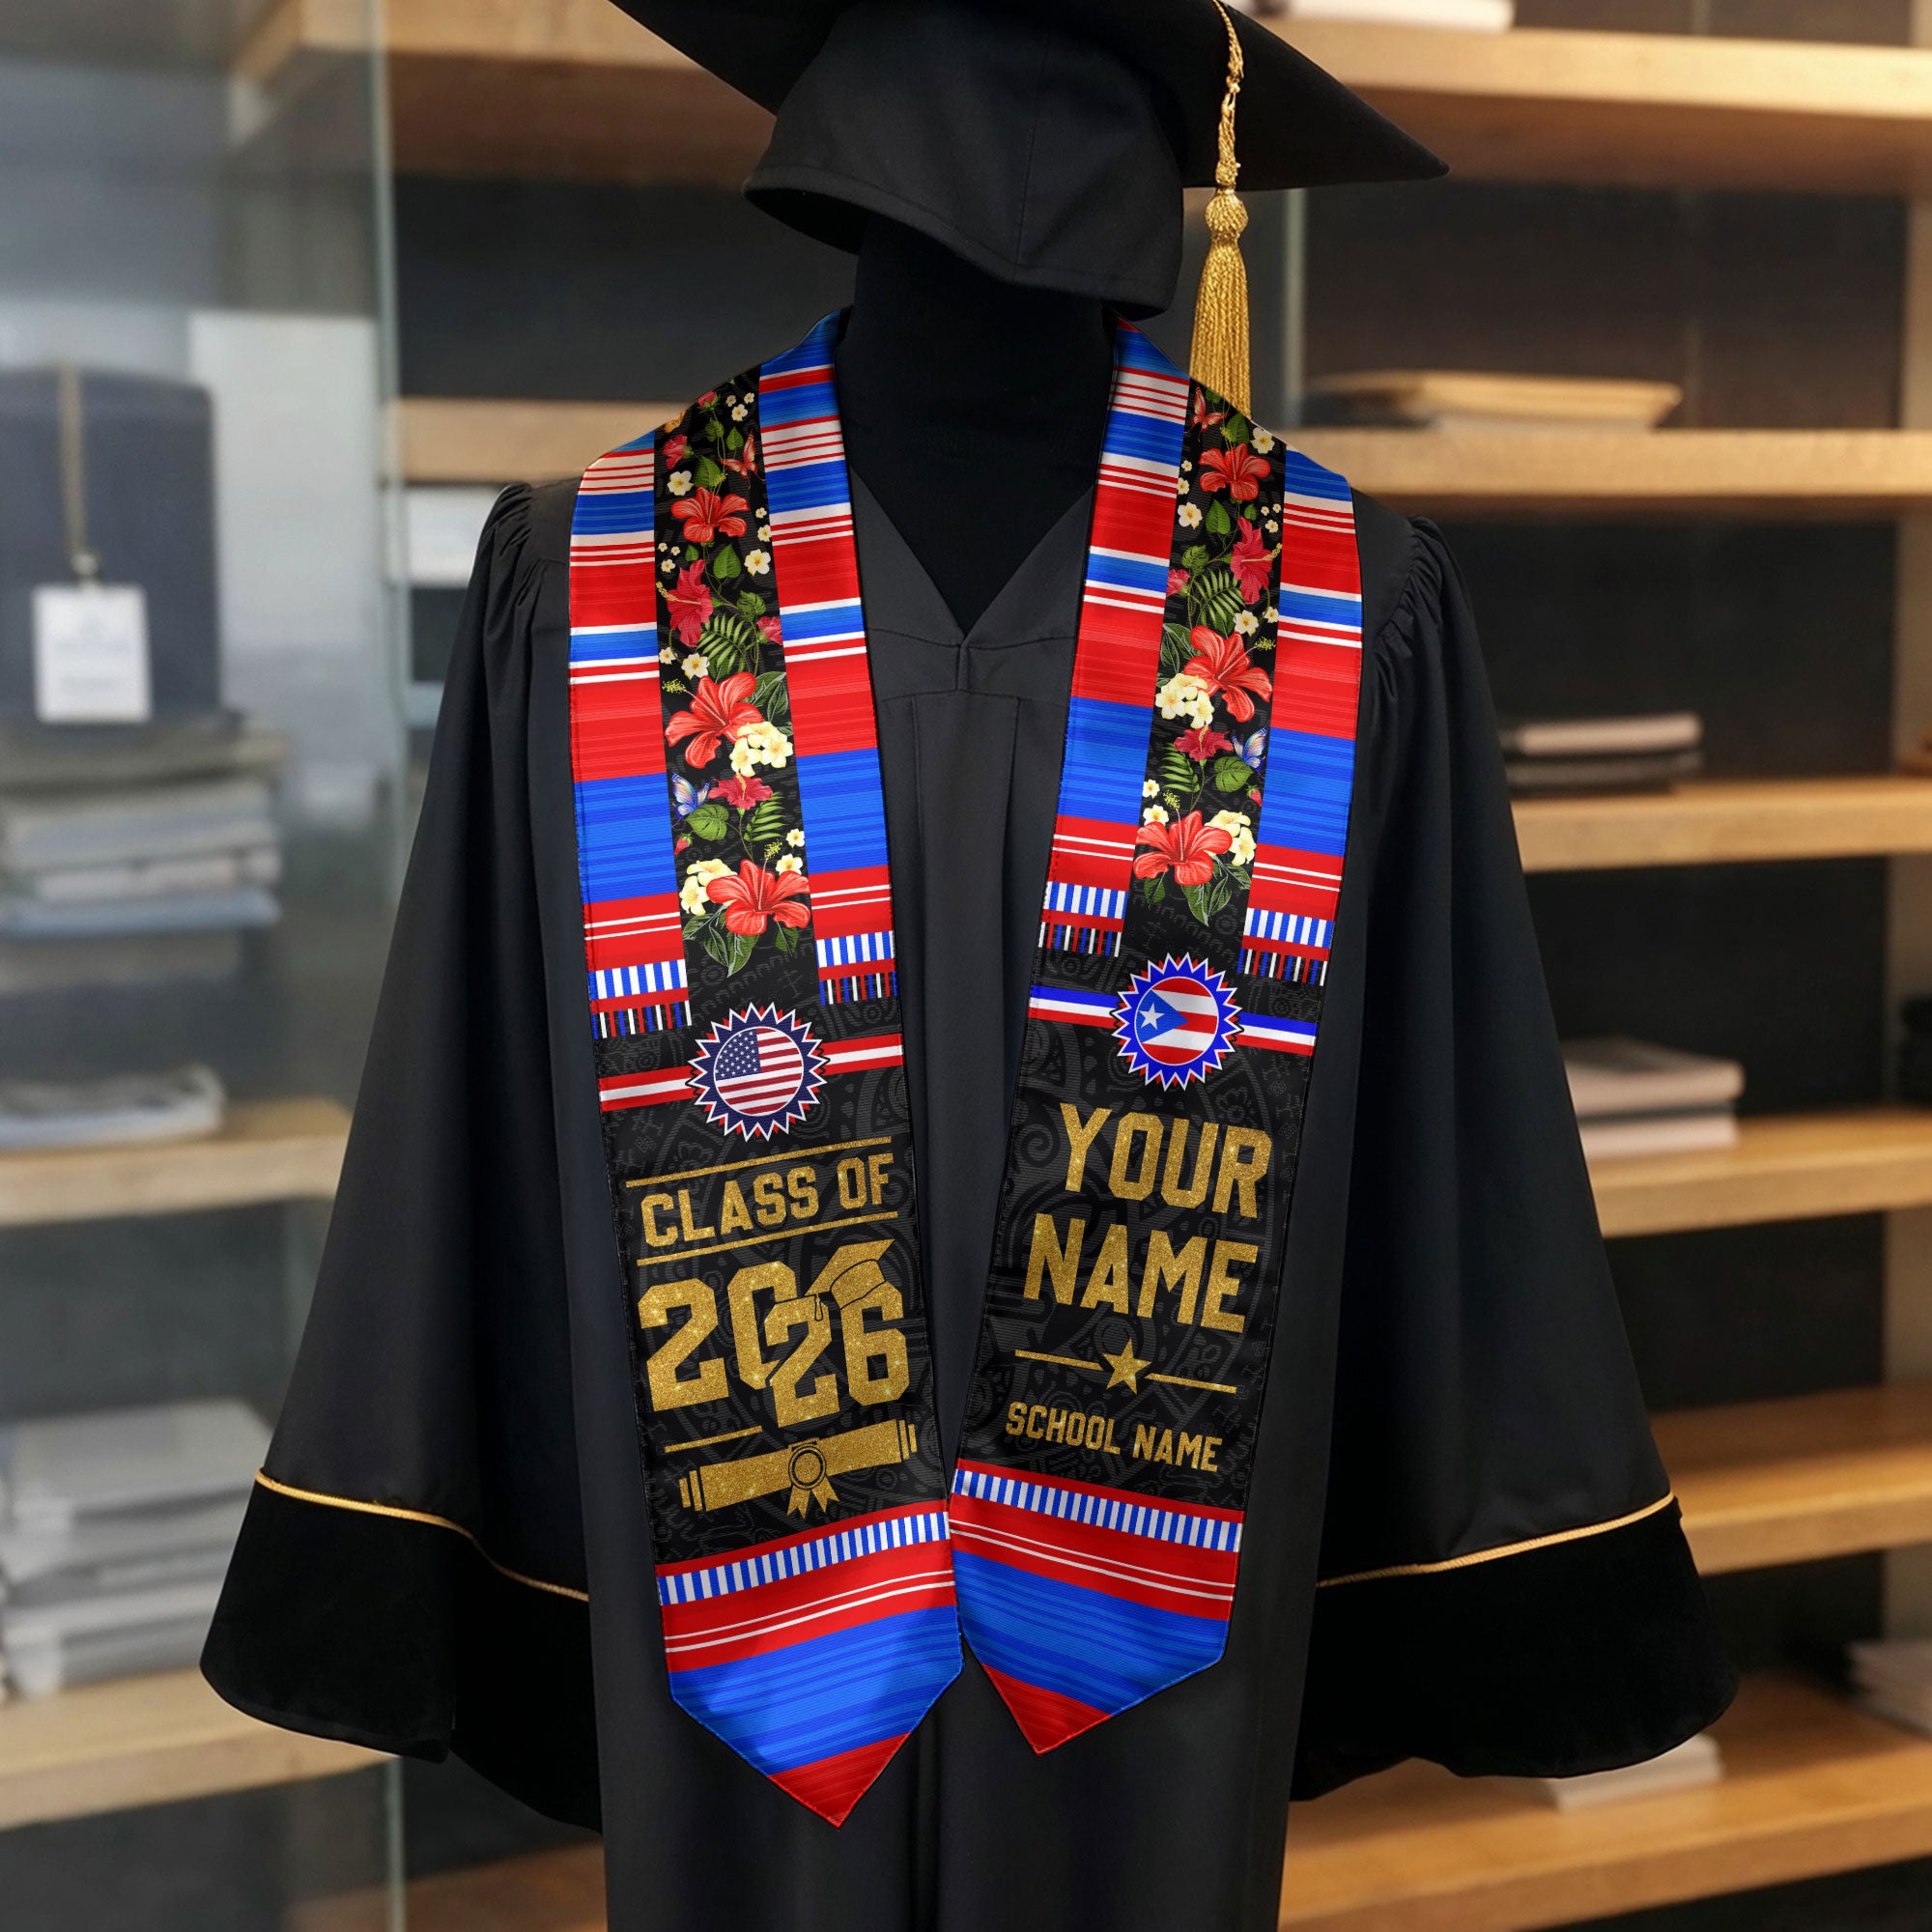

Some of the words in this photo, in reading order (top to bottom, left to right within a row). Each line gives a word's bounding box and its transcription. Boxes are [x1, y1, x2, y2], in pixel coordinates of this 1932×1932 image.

[640, 1165, 820, 1248] CLASS
[838, 1152, 895, 1210] OF
[1059, 1102, 1273, 1219] YOUR
[1023, 1212, 1259, 1334] NAME
[637, 1260, 911, 1429] 2026
[1006, 1401, 1122, 1455] SCHOOL
[1132, 1423, 1223, 1473] NAME
